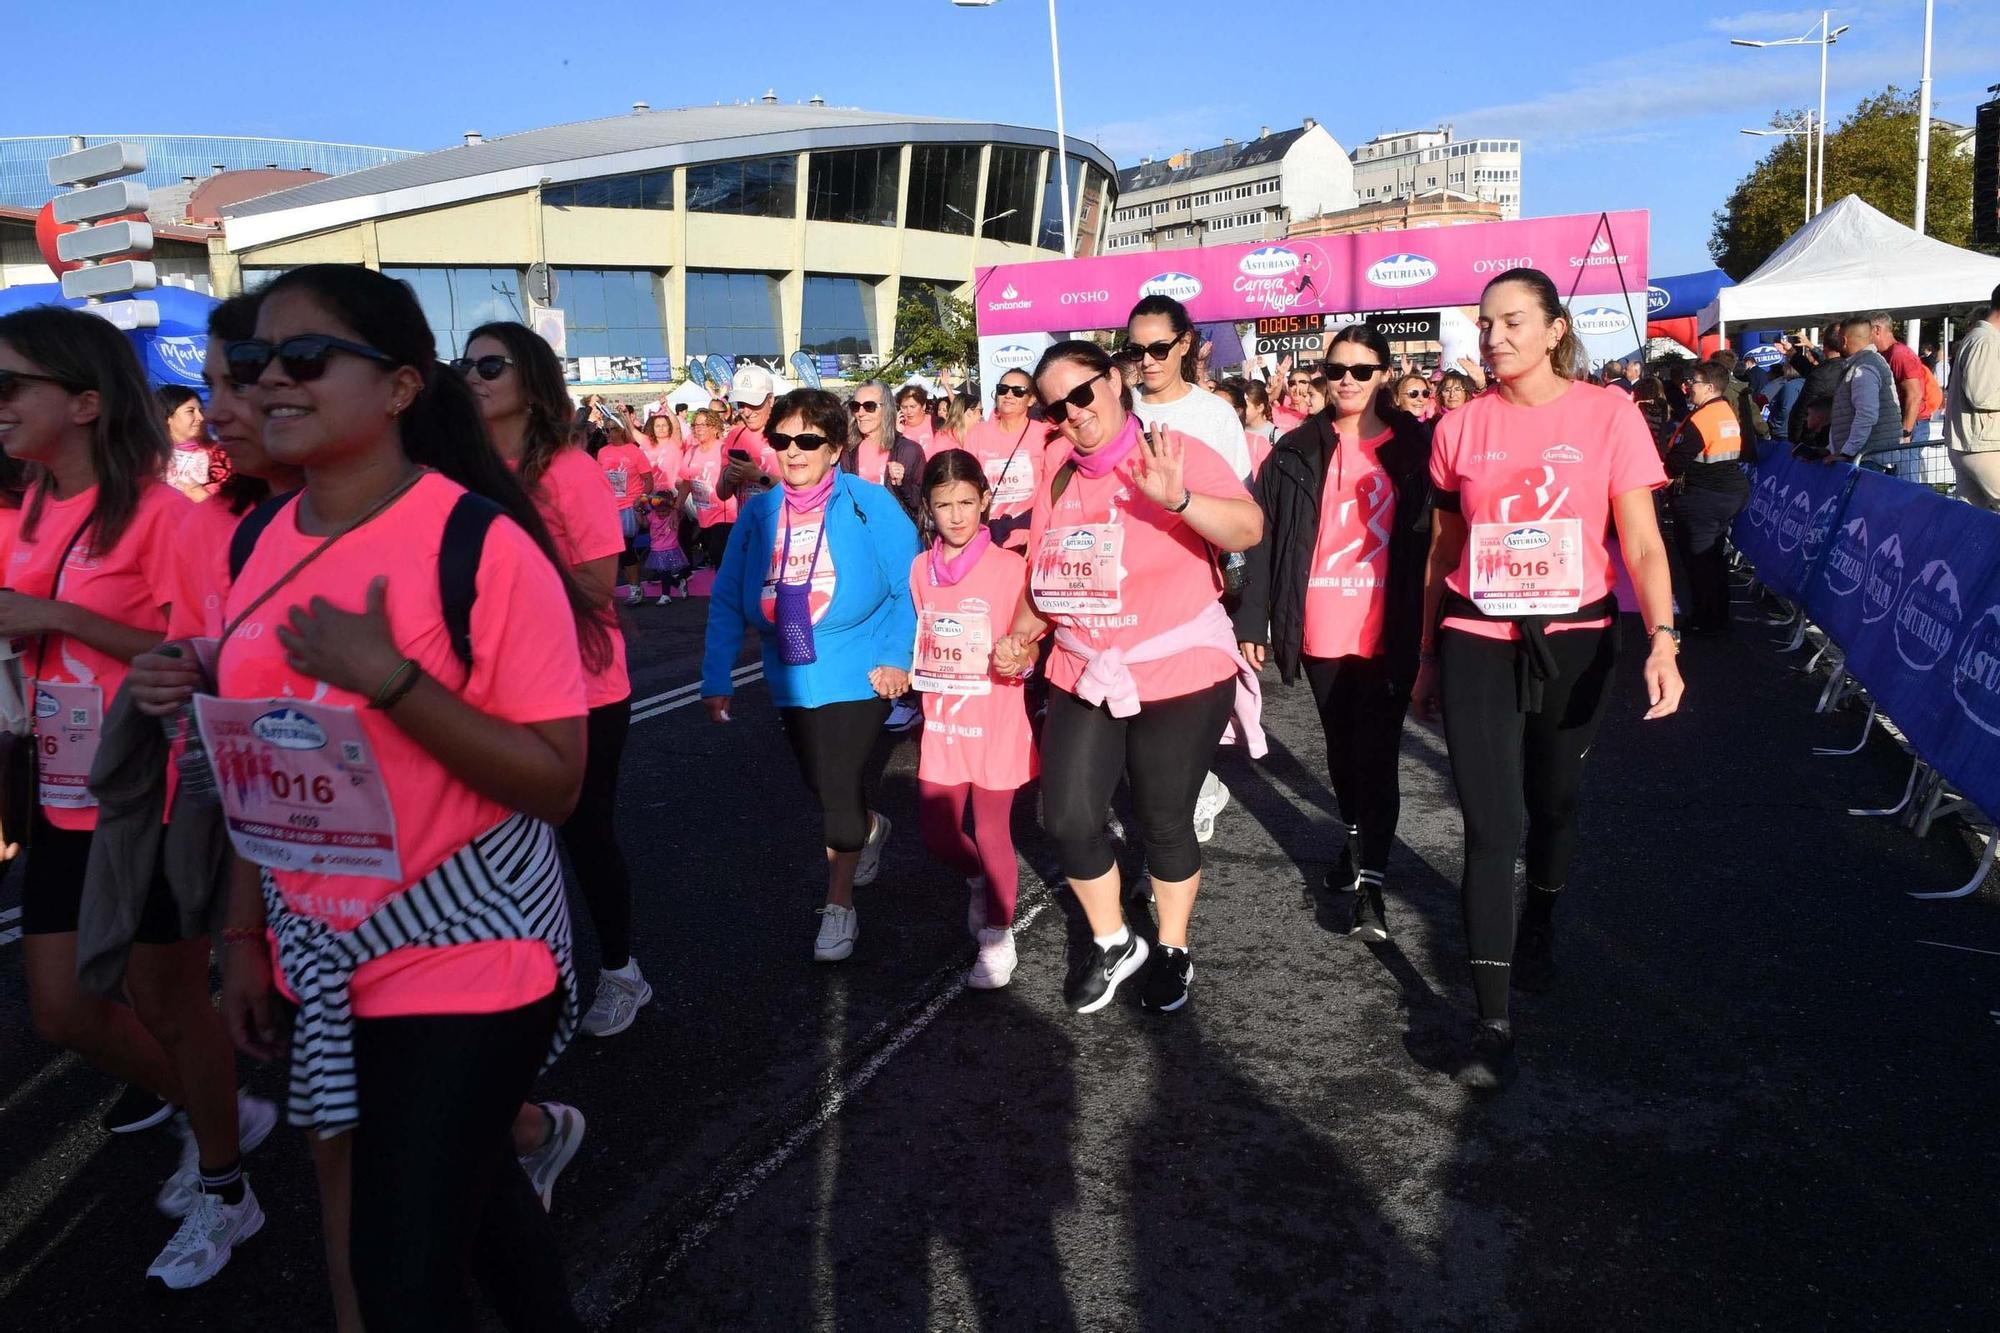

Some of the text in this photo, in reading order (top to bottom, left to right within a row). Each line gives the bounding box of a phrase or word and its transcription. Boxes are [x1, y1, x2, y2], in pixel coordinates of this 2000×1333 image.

[1243, 257, 1296, 270] ASTURIANA
[1473, 257, 1533, 273] OYSHO
[1569, 255, 1628, 267] Santander
[1372, 266, 1432, 280] ASTURIANA
[1233, 276, 1285, 292] Carrera
[988, 299, 1032, 311] Santander
[1060, 290, 1109, 305] OYSHO
[1262, 287, 1303, 312] Mujer
[1376, 321, 1430, 335] OYSHO
[1574, 319, 1627, 330] ASTURIANA
[1258, 336, 1321, 353] OYSHO
[1505, 534, 1548, 547] ASTURIANA
[788, 552, 815, 567] 016
[1061, 561, 1092, 577] 016
[1508, 561, 1549, 577] 016
[1094, 616, 1106, 628] LA
[1107, 614, 1138, 628] MUJER
[933, 646, 962, 662] 016
[271, 770, 334, 804] 016
